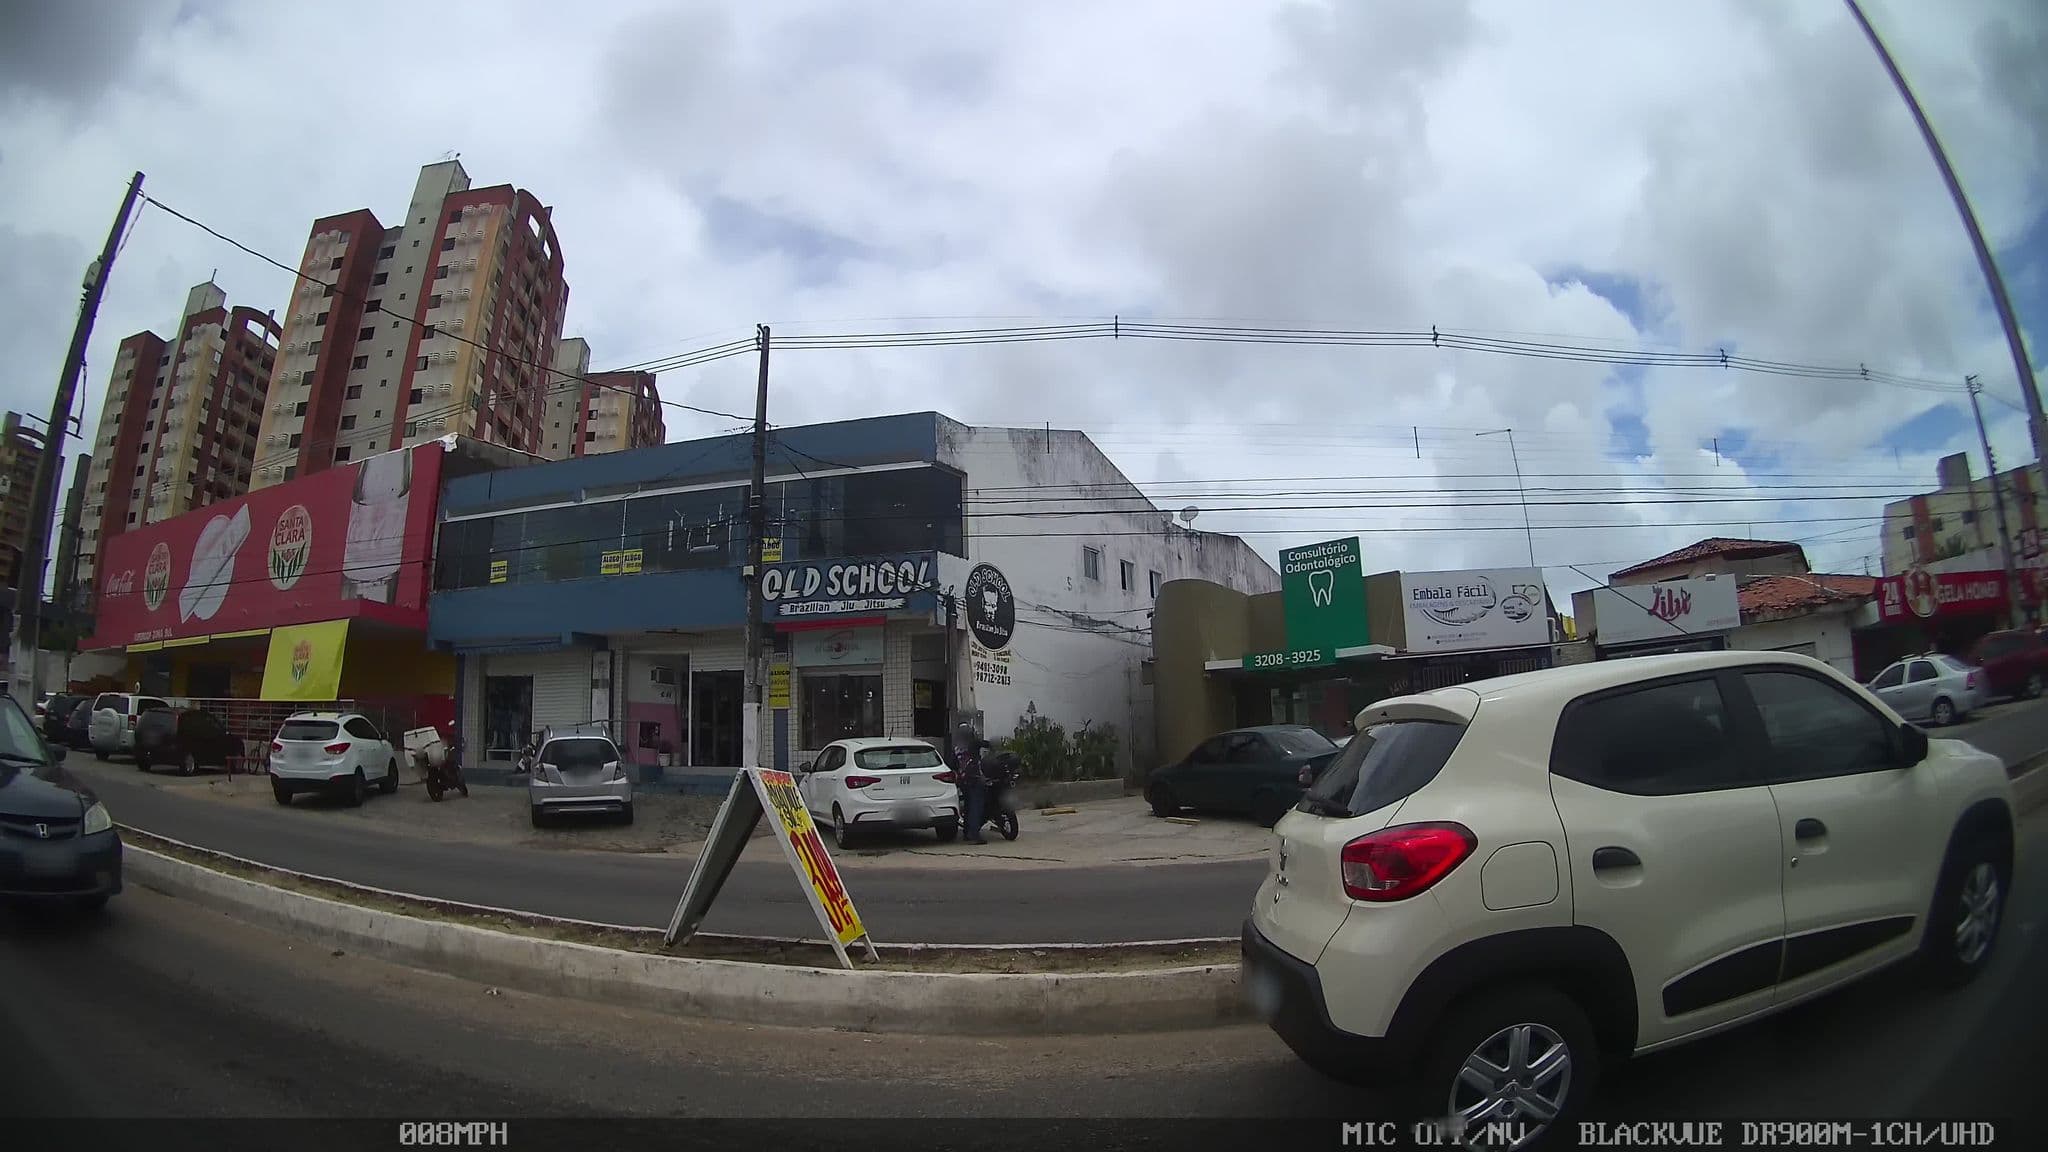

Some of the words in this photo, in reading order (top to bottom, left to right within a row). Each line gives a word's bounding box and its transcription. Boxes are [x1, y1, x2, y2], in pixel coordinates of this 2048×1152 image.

[280, 516, 303, 531] SANTA
[275, 528, 305, 546] CLARA
[1288, 543, 1348, 561] Consultório
[1285, 554, 1356, 573] Odontológico
[762, 567, 821, 600] OLD
[826, 561, 932, 596] SCHOOL
[968, 571, 982, 597] OLD
[982, 568, 1011, 603] SCHOOL
[1413, 585, 1452, 600] Embala
[1457, 584, 1488, 598] Fácil
[789, 602, 830, 613] Brazilian
[841, 601, 855, 610] Jiu
[864, 600, 886, 609] Jitsu
